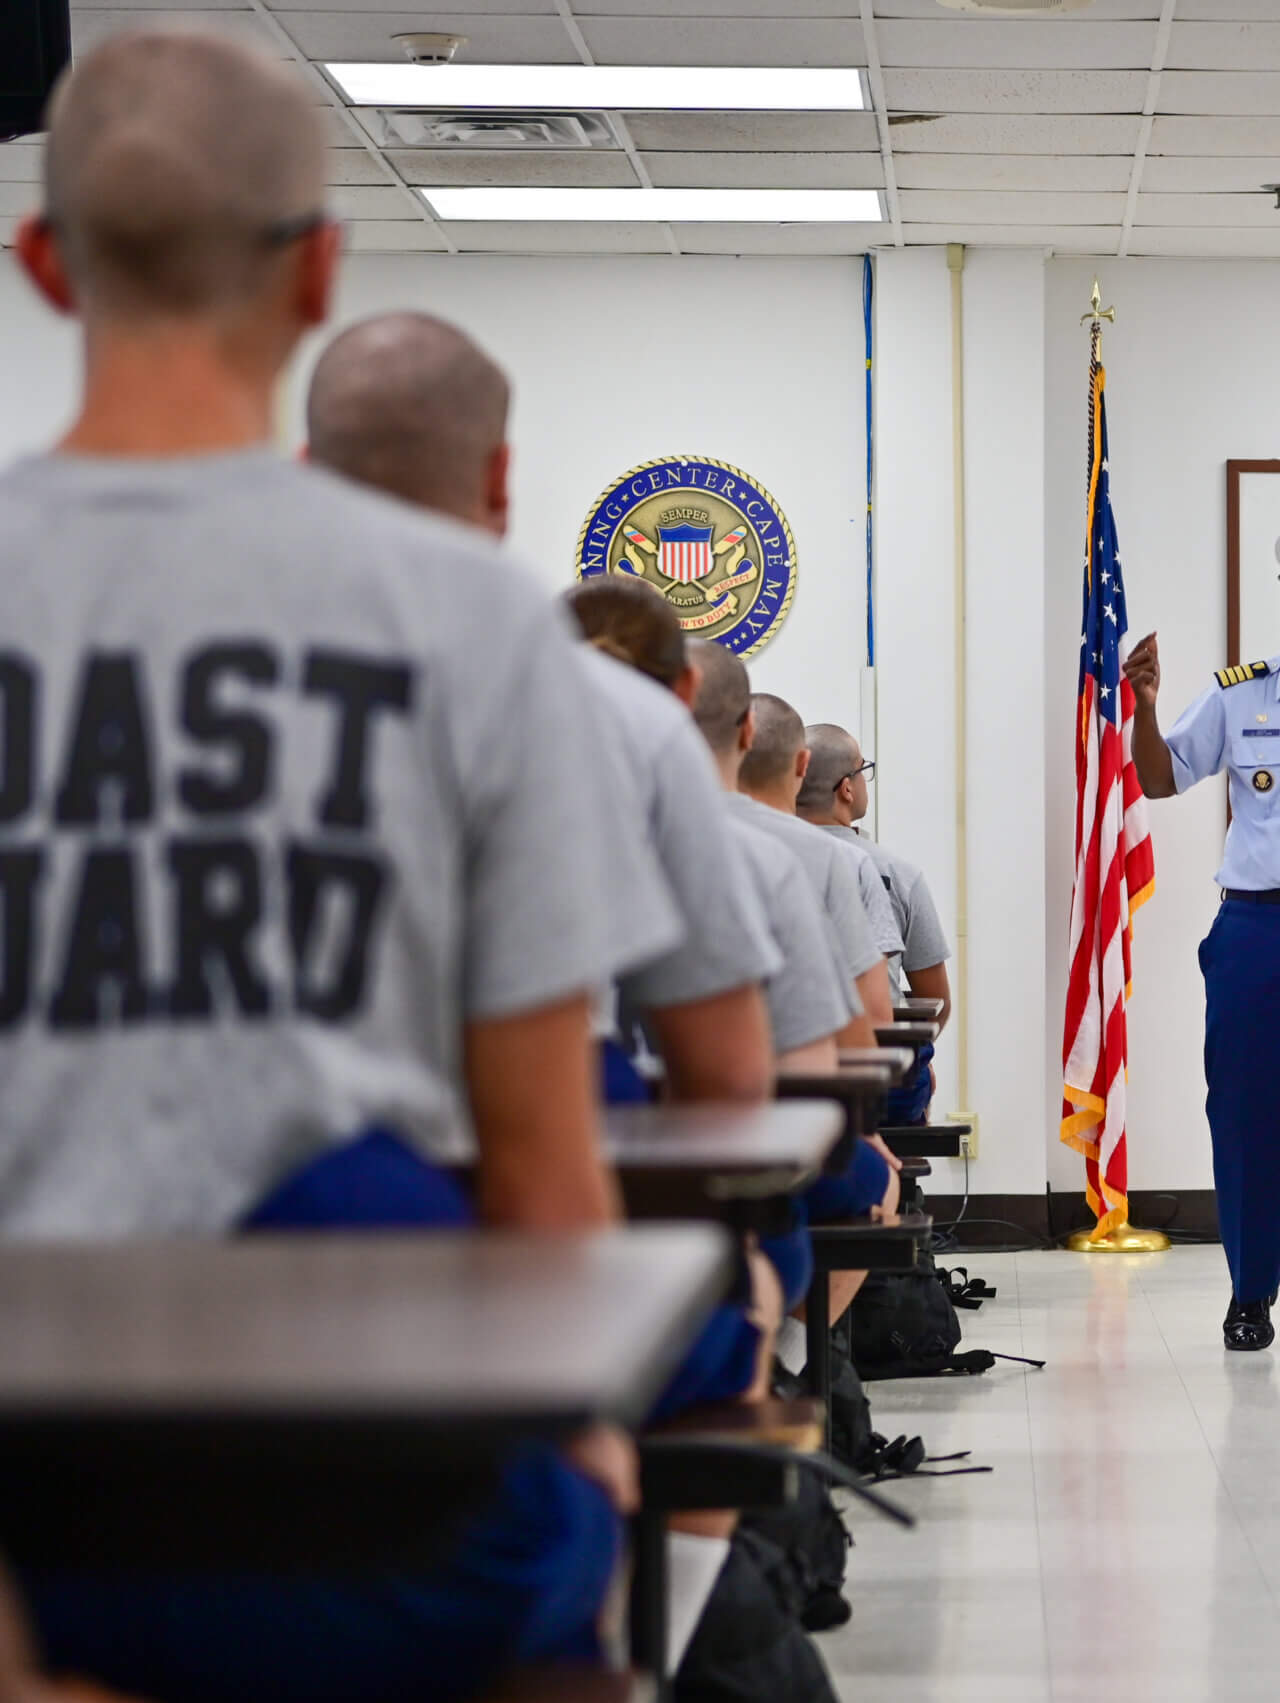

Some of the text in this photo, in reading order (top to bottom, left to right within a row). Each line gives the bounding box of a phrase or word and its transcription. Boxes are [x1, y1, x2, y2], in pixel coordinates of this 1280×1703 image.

[631, 467, 737, 497] CENTER
[661, 508, 708, 523] SEMPER
[746, 501, 784, 567] CAPE
[668, 594, 704, 606] PARATUS
[746, 578, 783, 635] MAY
[691, 618, 705, 627] TO
[707, 602, 731, 623] DUTY
